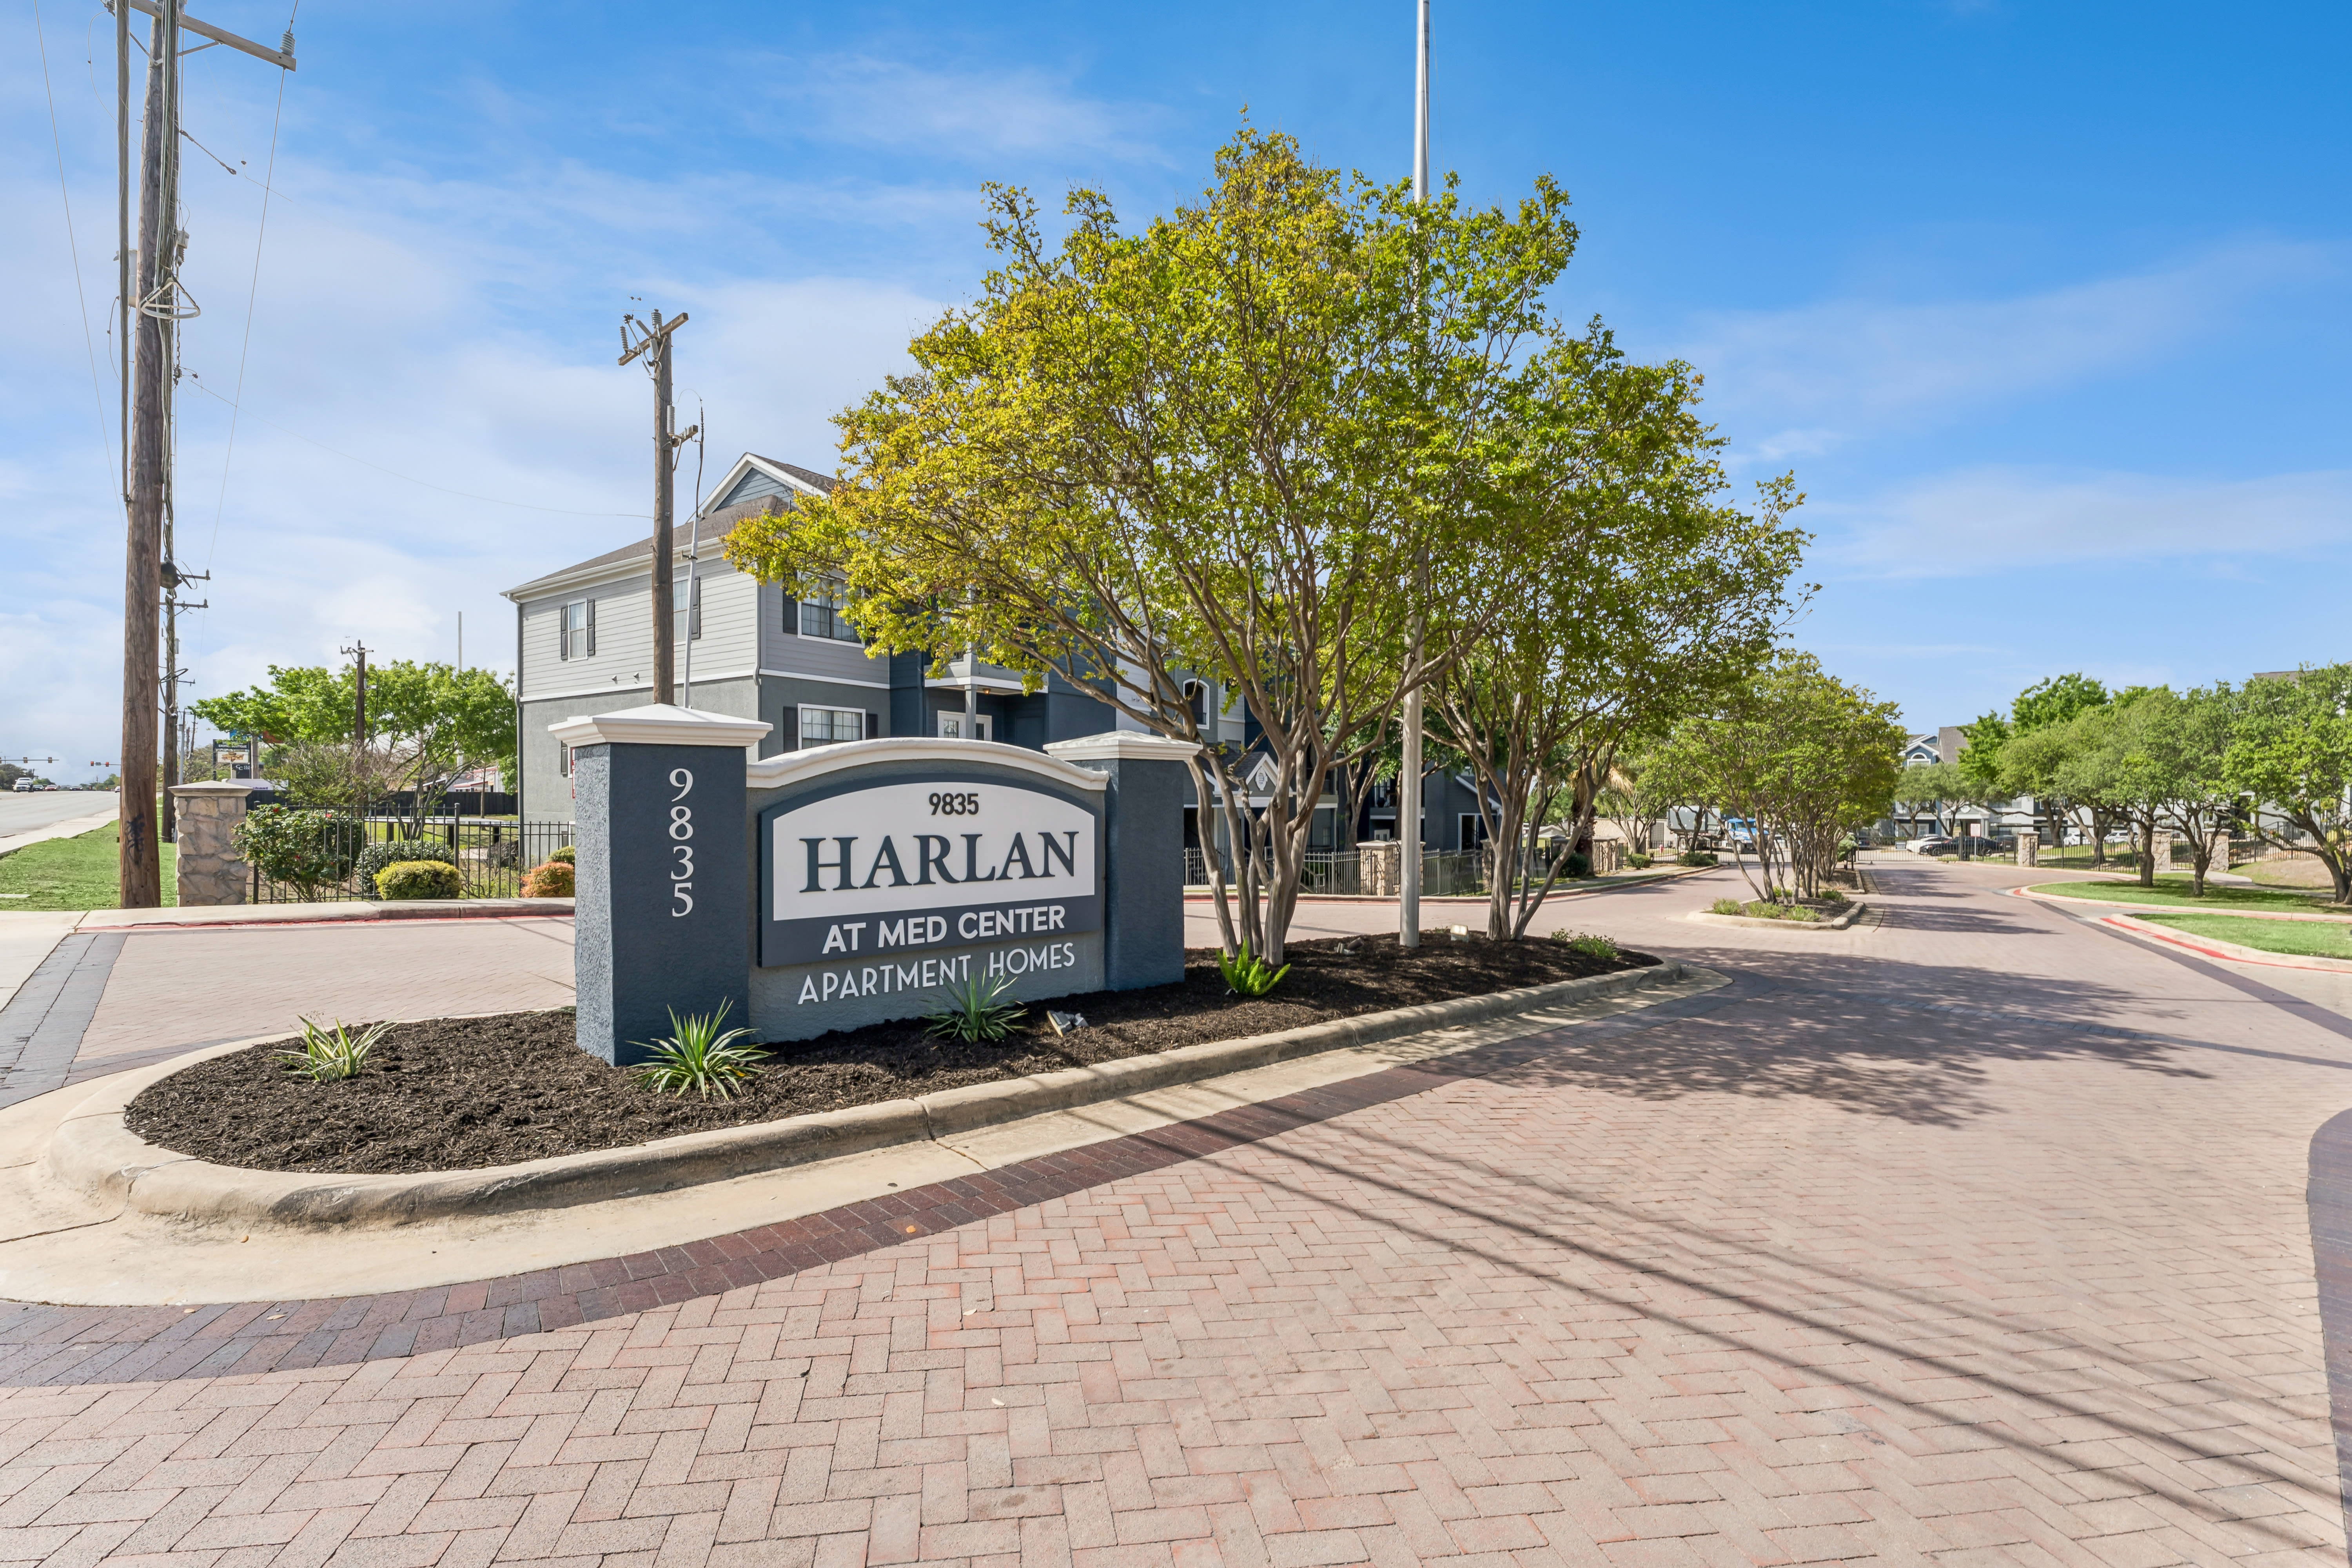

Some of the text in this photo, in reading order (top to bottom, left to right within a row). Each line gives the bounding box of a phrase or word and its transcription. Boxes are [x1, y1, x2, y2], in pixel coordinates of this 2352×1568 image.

[929, 793, 979, 815] 9835
[669, 768, 693, 917] 9835
[799, 831, 1079, 893] HARLAN
[822, 905, 1065, 954] AT MED CENTER
[797, 942, 1075, 1005] APARTMENT HOMES
